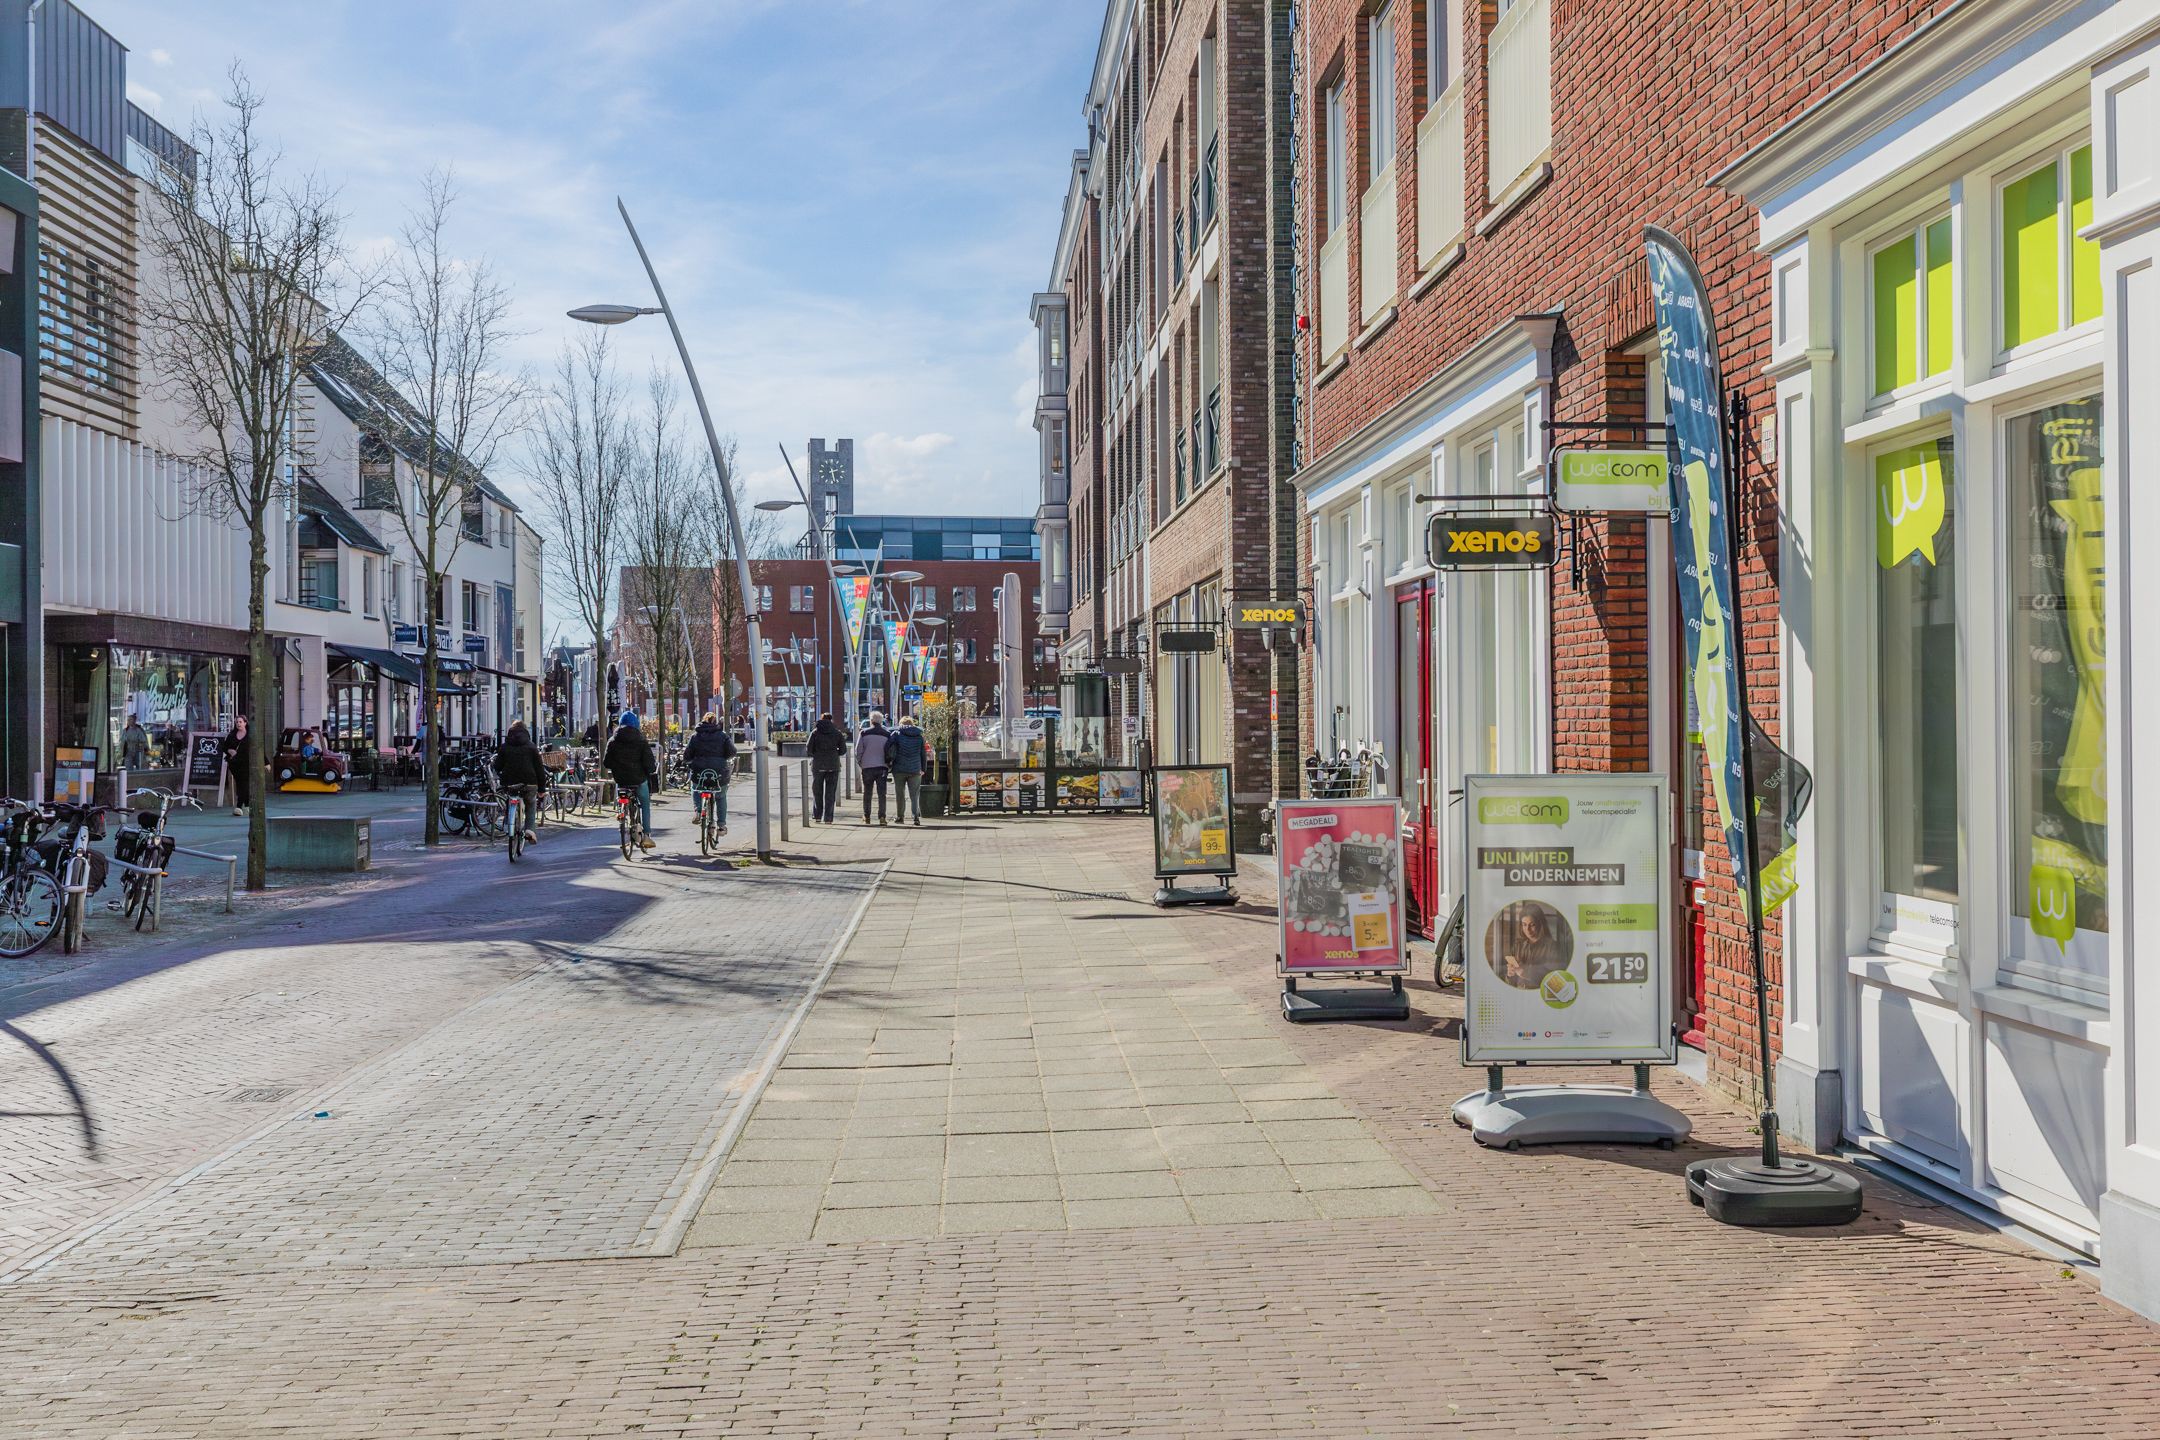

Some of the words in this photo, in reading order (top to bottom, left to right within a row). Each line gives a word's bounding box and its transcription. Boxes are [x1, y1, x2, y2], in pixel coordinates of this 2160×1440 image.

[1570, 459, 1659, 478] welcom
[1448, 530, 1541, 553] xenos
[1241, 608, 1296, 622] xenos
[1484, 803, 1562, 817] welcom
[1581, 808, 1637, 816] telecomspecialist
[1292, 816, 1334, 828] MEGADEAL!
[1483, 851, 1569, 865] UNLIMITED
[1509, 868, 1620, 882] ONDERNEMEN
[1324, 950, 1360, 960] xenos
